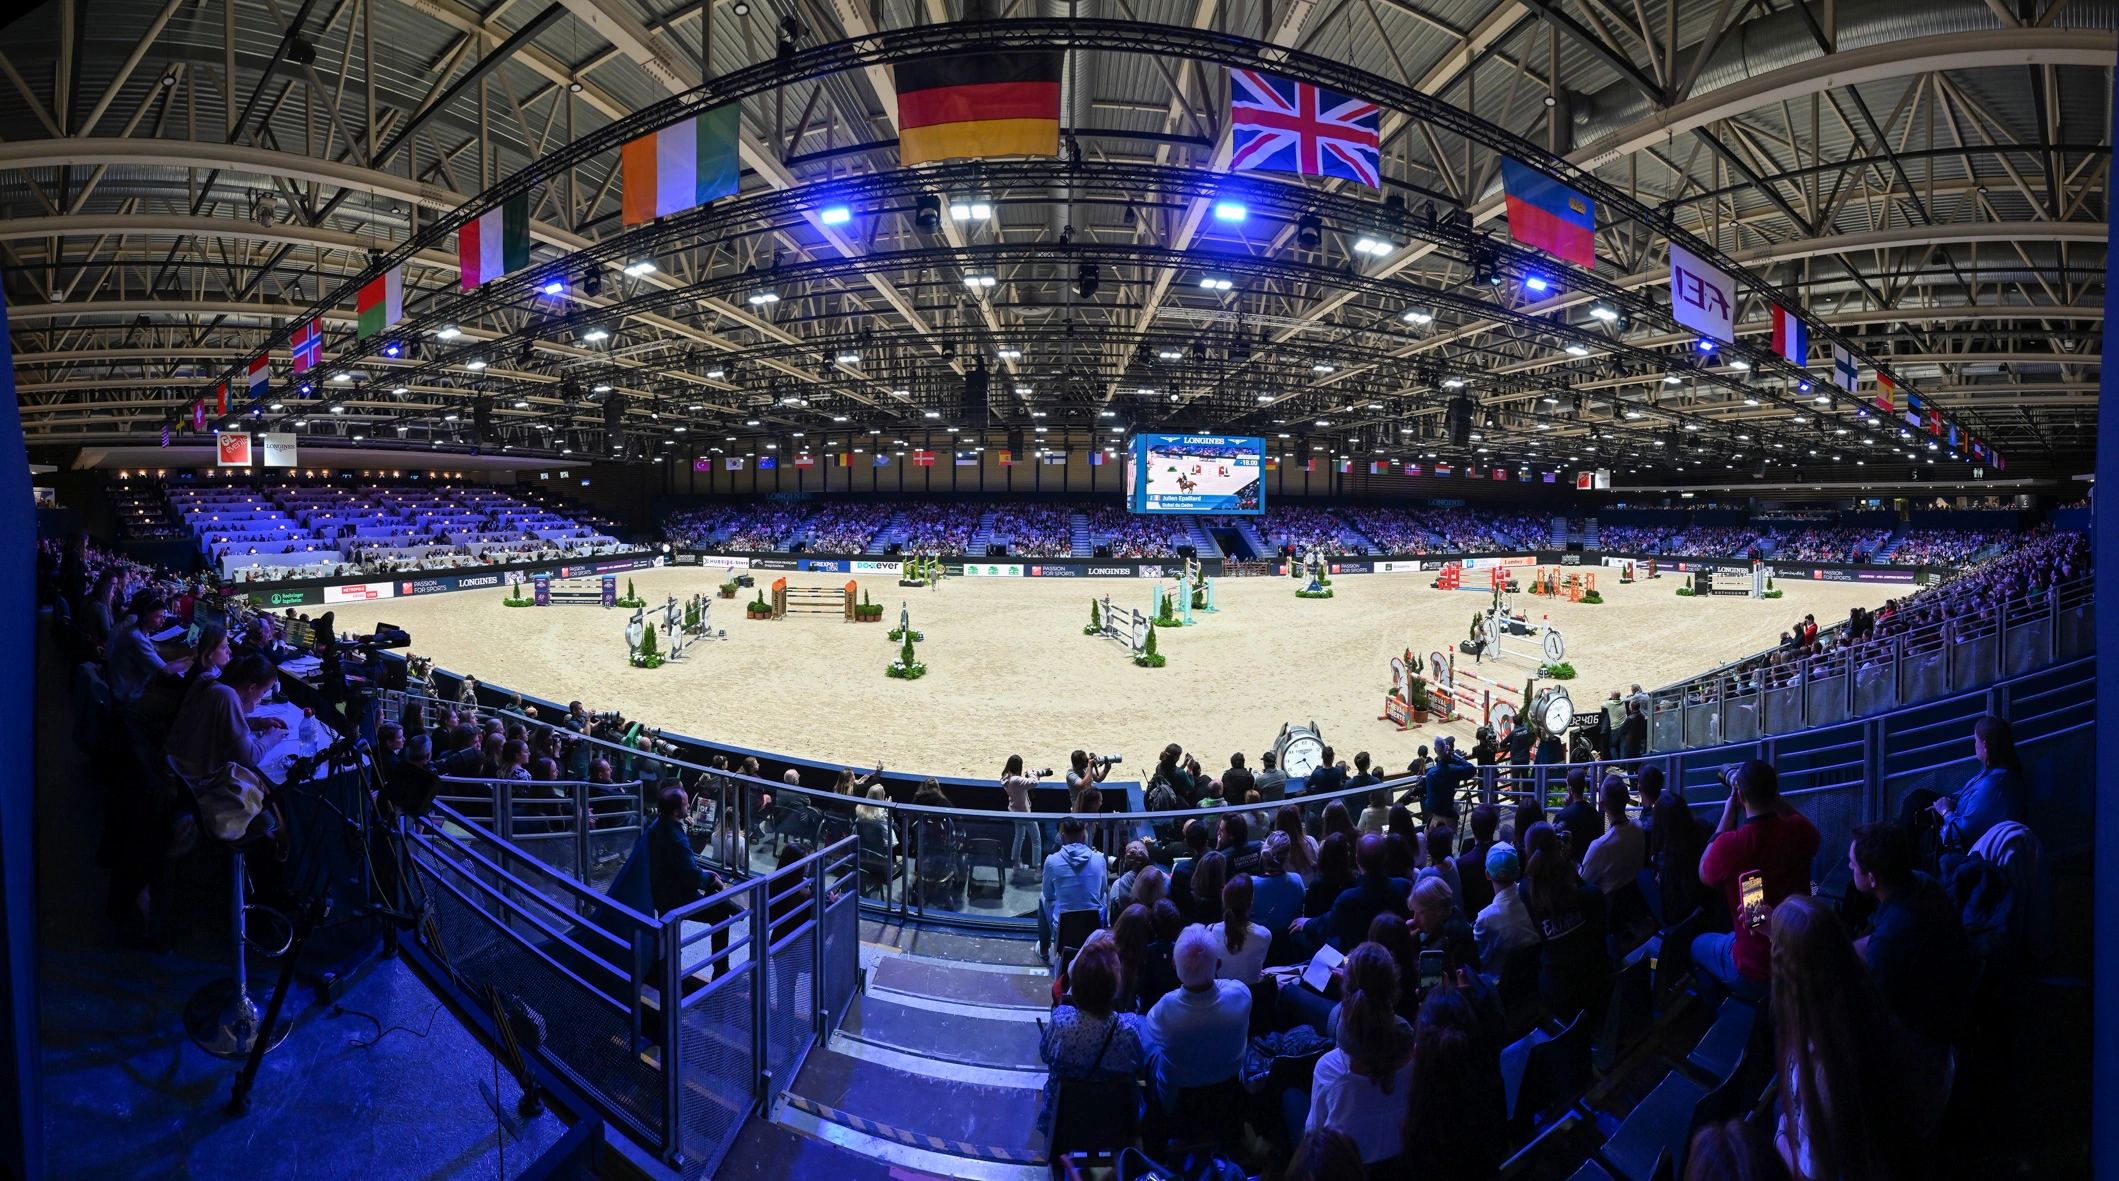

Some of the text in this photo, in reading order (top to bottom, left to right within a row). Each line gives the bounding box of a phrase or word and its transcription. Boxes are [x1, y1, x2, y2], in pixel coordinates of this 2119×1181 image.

[221, 434, 237, 447] GL
[225, 436, 249, 454] events
[1183, 436, 1225, 445] LONGINES
[1087, 567, 1131, 575] LONGINES
[1717, 566, 1749, 574] LONGINES
[458, 576, 498, 587] LONGINES
[427, 585, 447, 593] SPORTS
[282, 592, 304, 600] Boehringer
[1548, 637, 1559, 654] A
